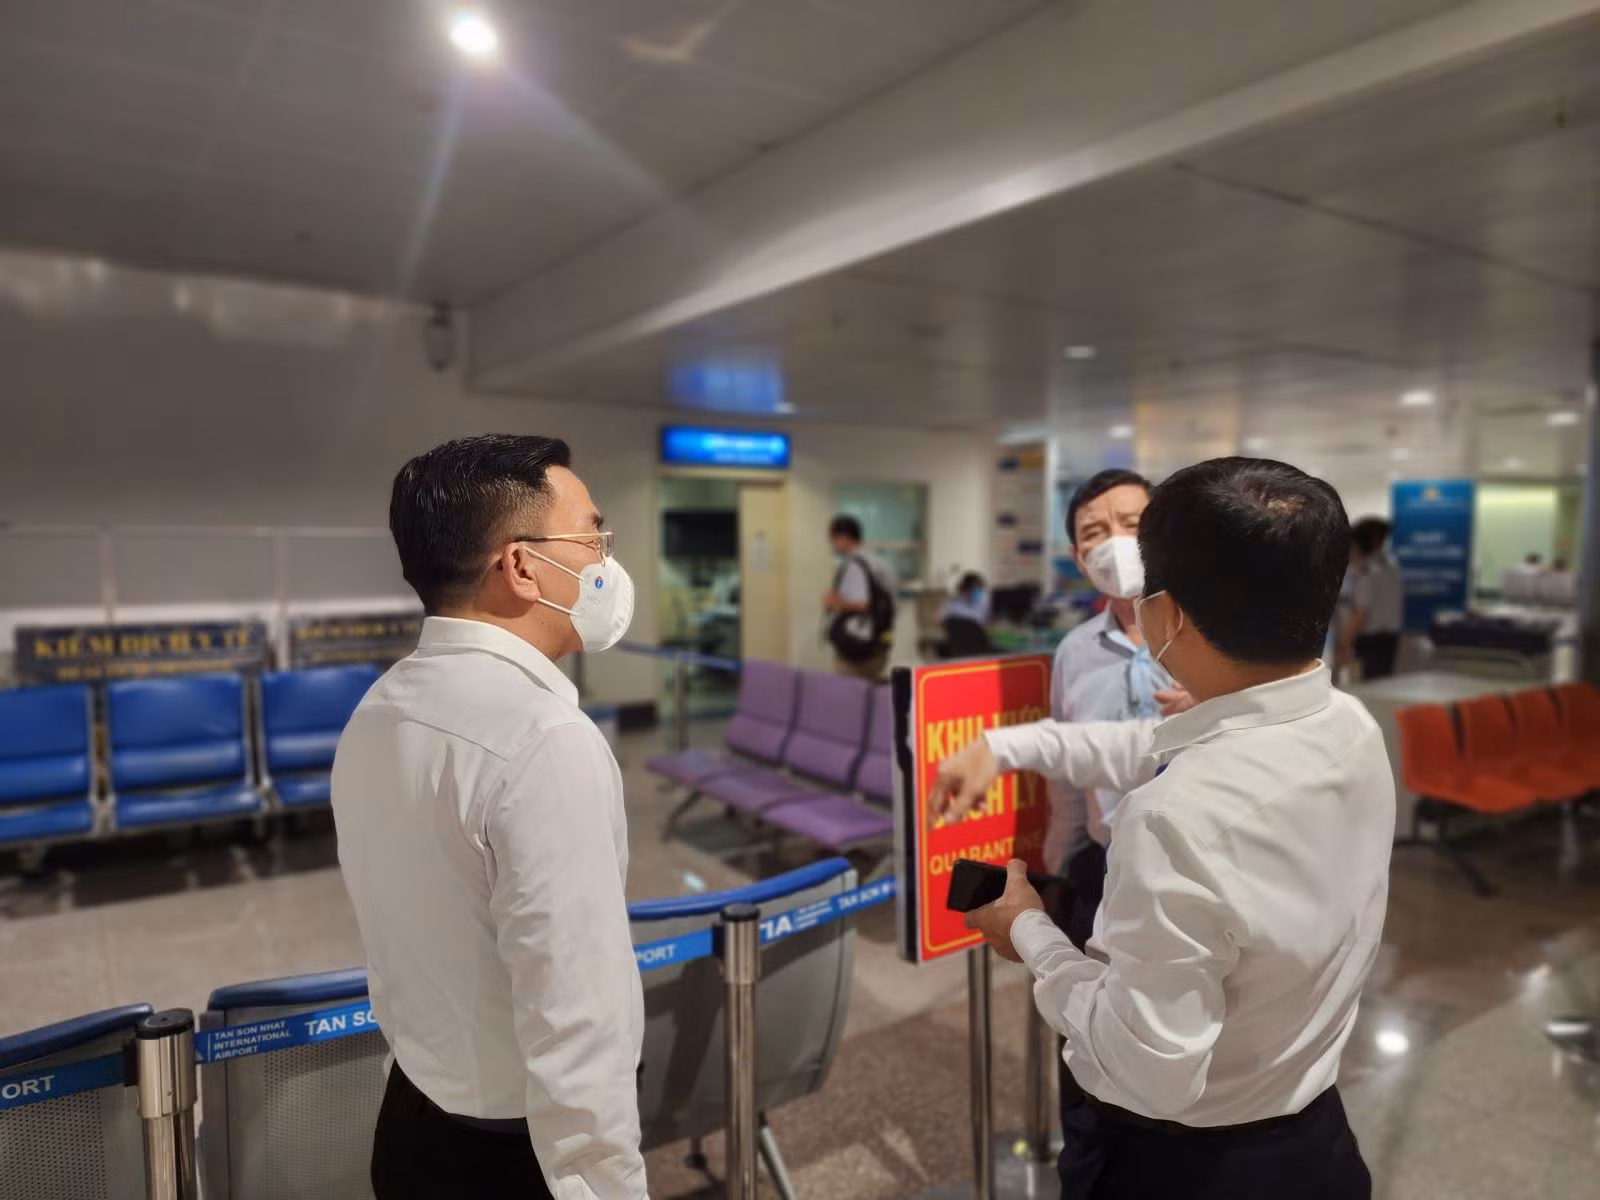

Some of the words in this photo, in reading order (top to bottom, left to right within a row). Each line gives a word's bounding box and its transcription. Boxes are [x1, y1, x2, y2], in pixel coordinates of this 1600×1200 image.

[214, 1029, 234, 1040] TAN
[236, 1022, 258, 1036] SON
[260, 1020, 286, 1032] NHAT
[304, 1014, 346, 1036] TAN
[214, 1030, 291, 1051] INTERNATIONAL
[214, 1045, 258, 1060] AIRPORT
